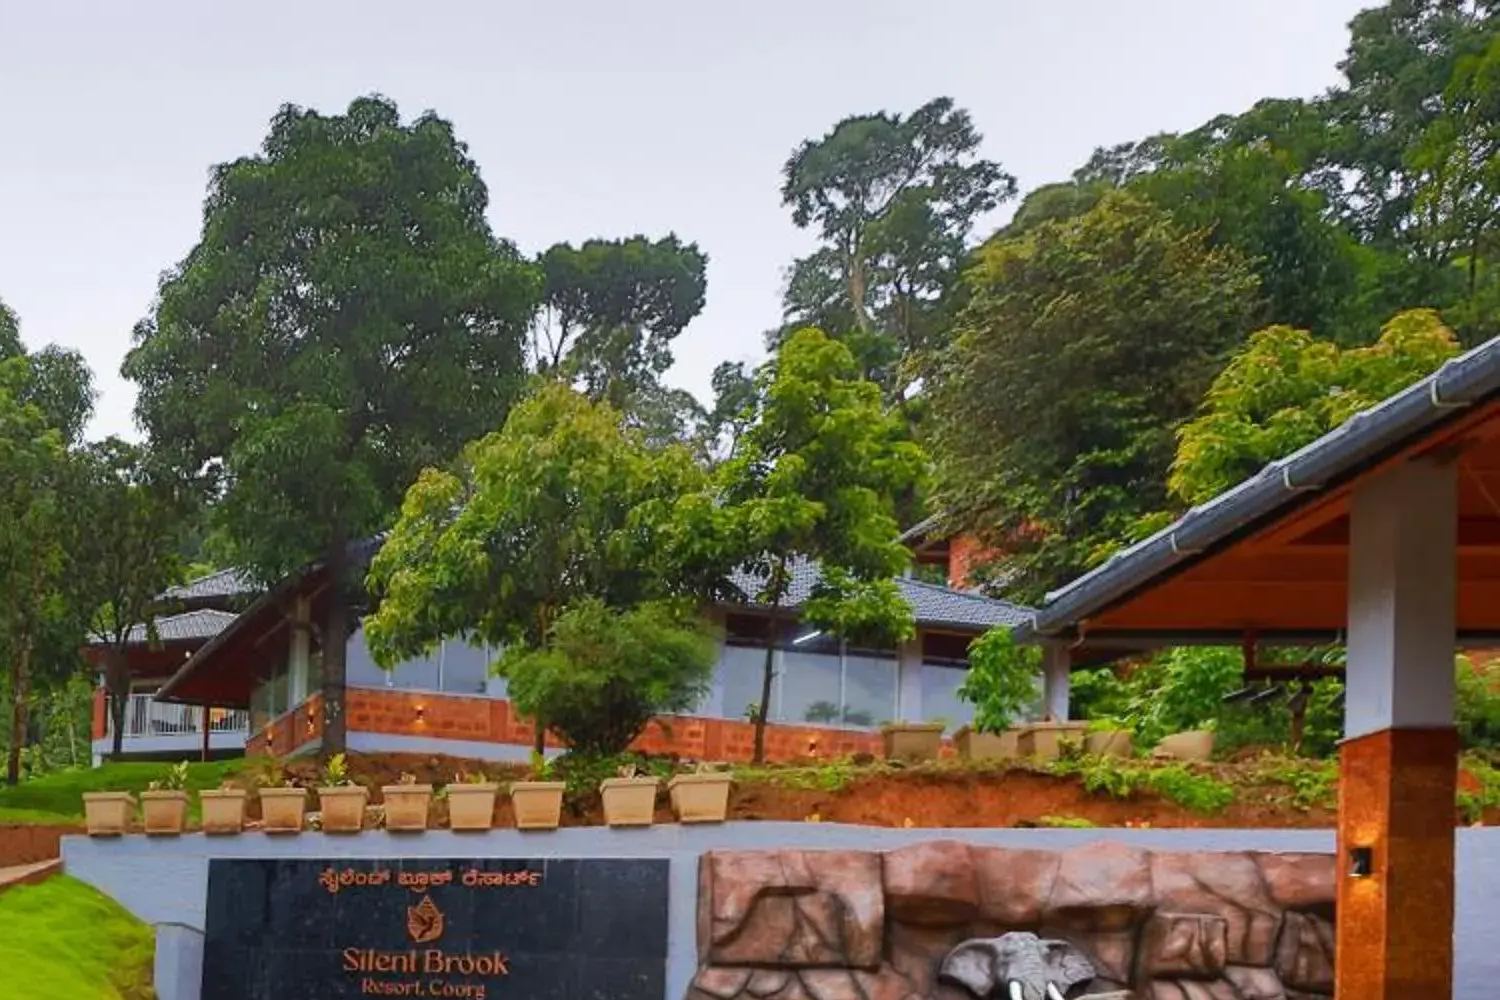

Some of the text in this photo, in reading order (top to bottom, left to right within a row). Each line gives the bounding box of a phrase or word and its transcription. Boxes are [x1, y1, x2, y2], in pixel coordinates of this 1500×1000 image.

[343, 947, 509, 975] Silent Brook
[429, 978, 486, 1000] Coorg
